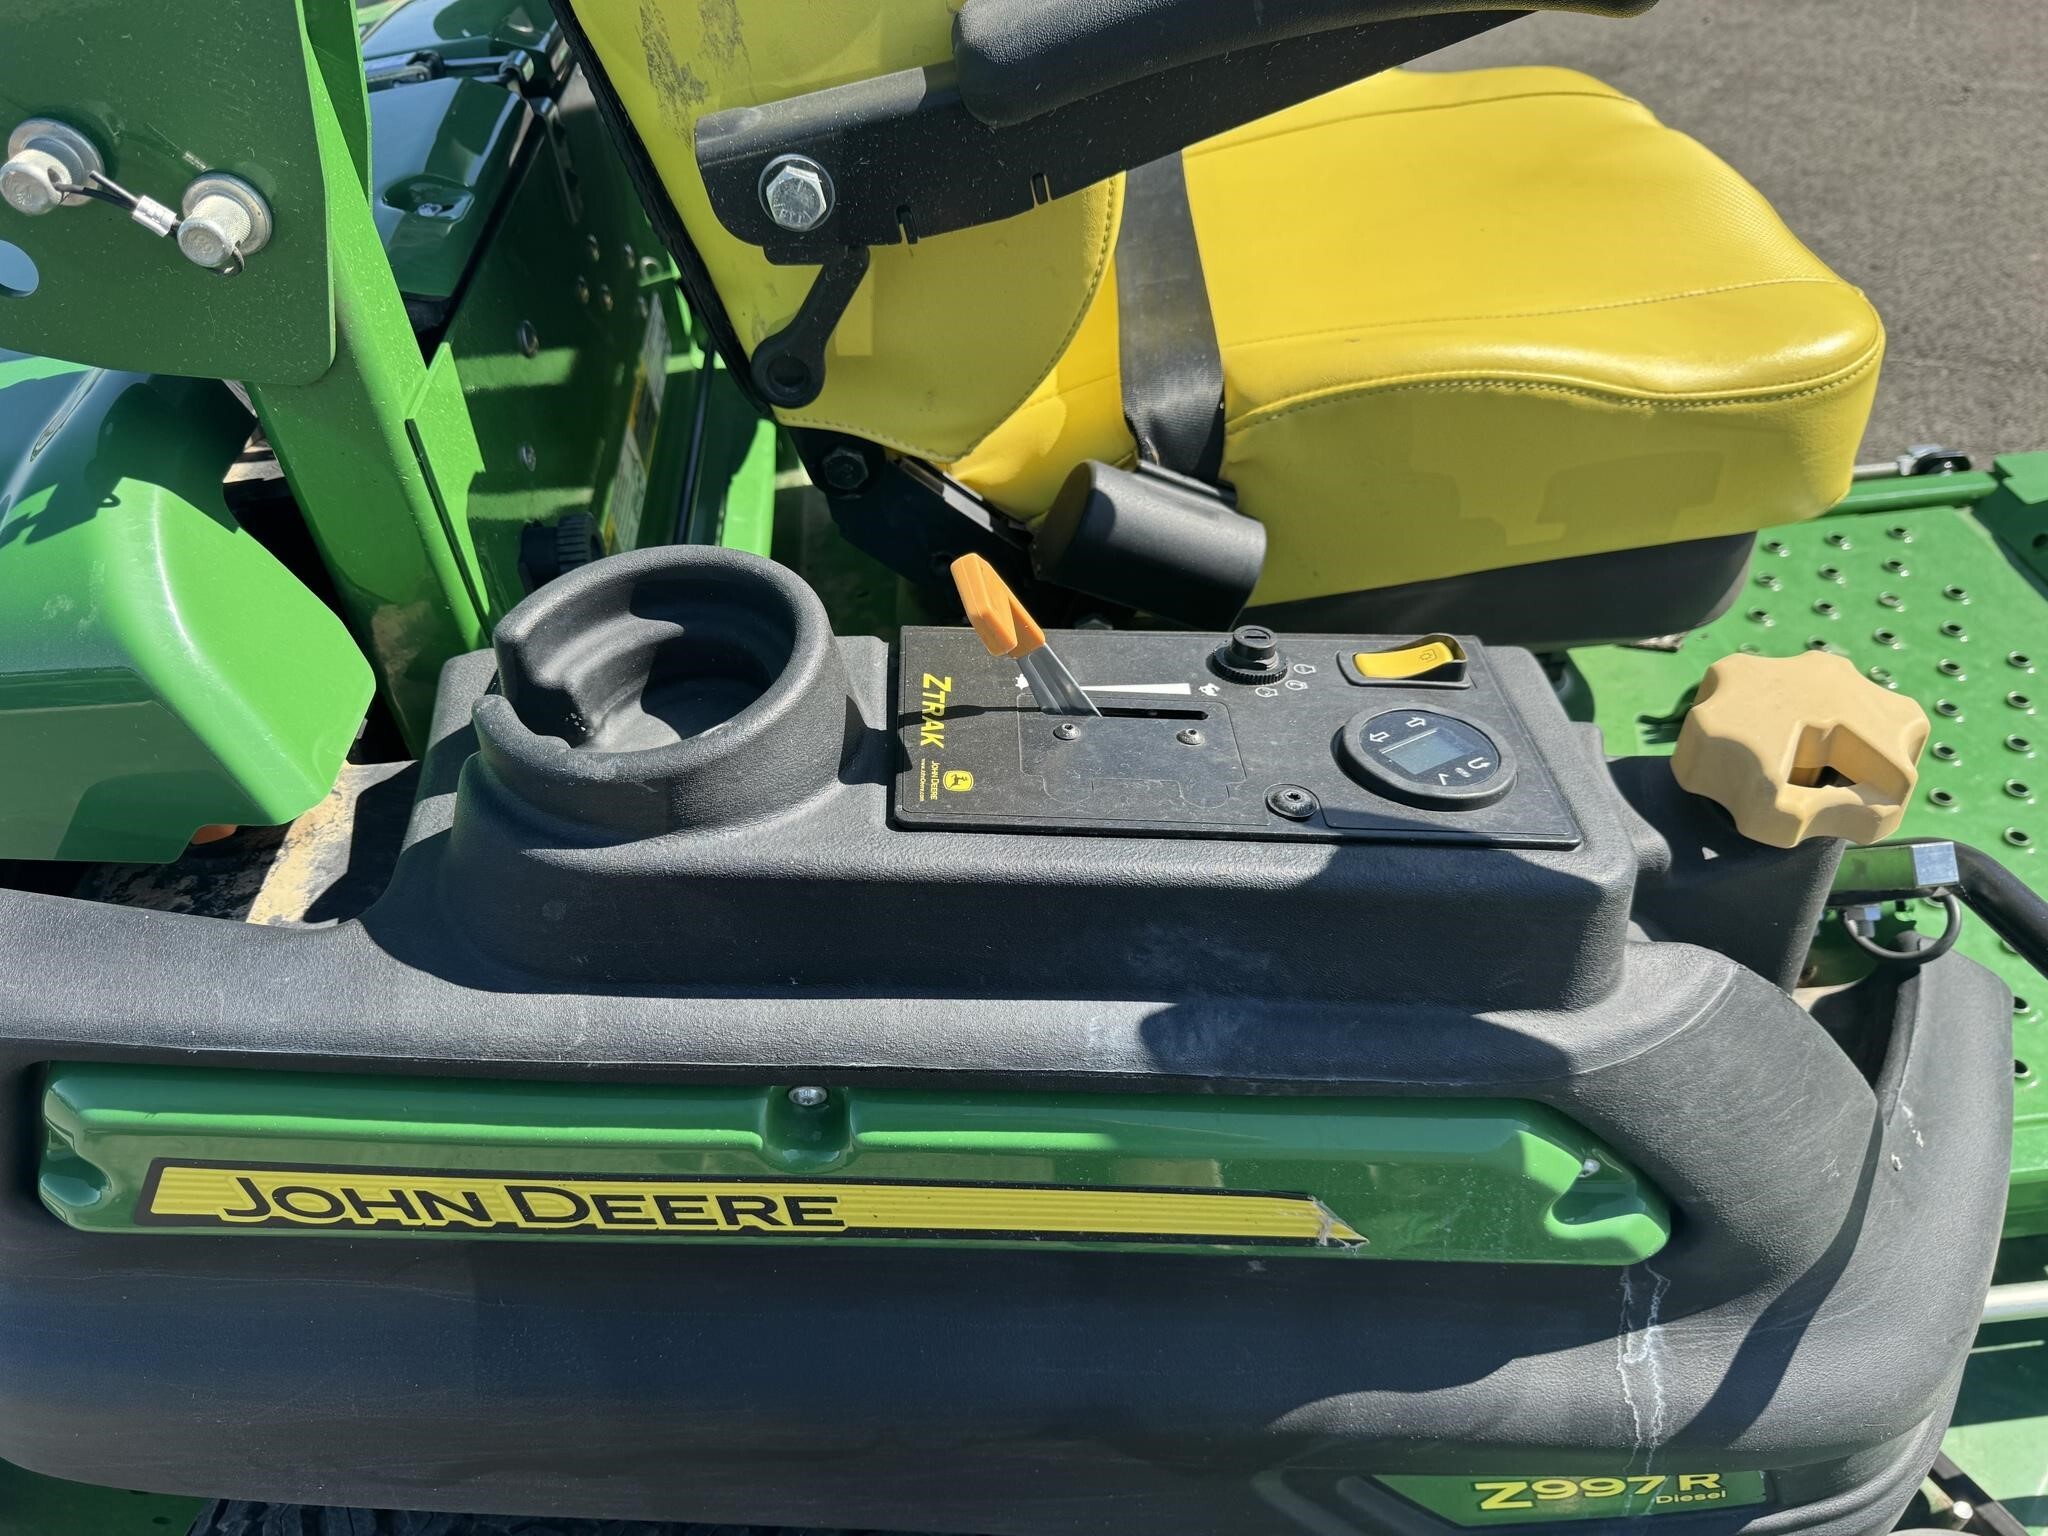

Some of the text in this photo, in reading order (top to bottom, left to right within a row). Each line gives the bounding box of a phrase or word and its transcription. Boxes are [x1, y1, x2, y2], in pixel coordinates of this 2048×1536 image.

[921, 673, 952, 749] ZTRAK
[930, 761, 940, 800] JOHN DEERE
[222, 1177, 846, 1228] JOHN DEERE
[1655, 1490, 1727, 1505] Diesel
